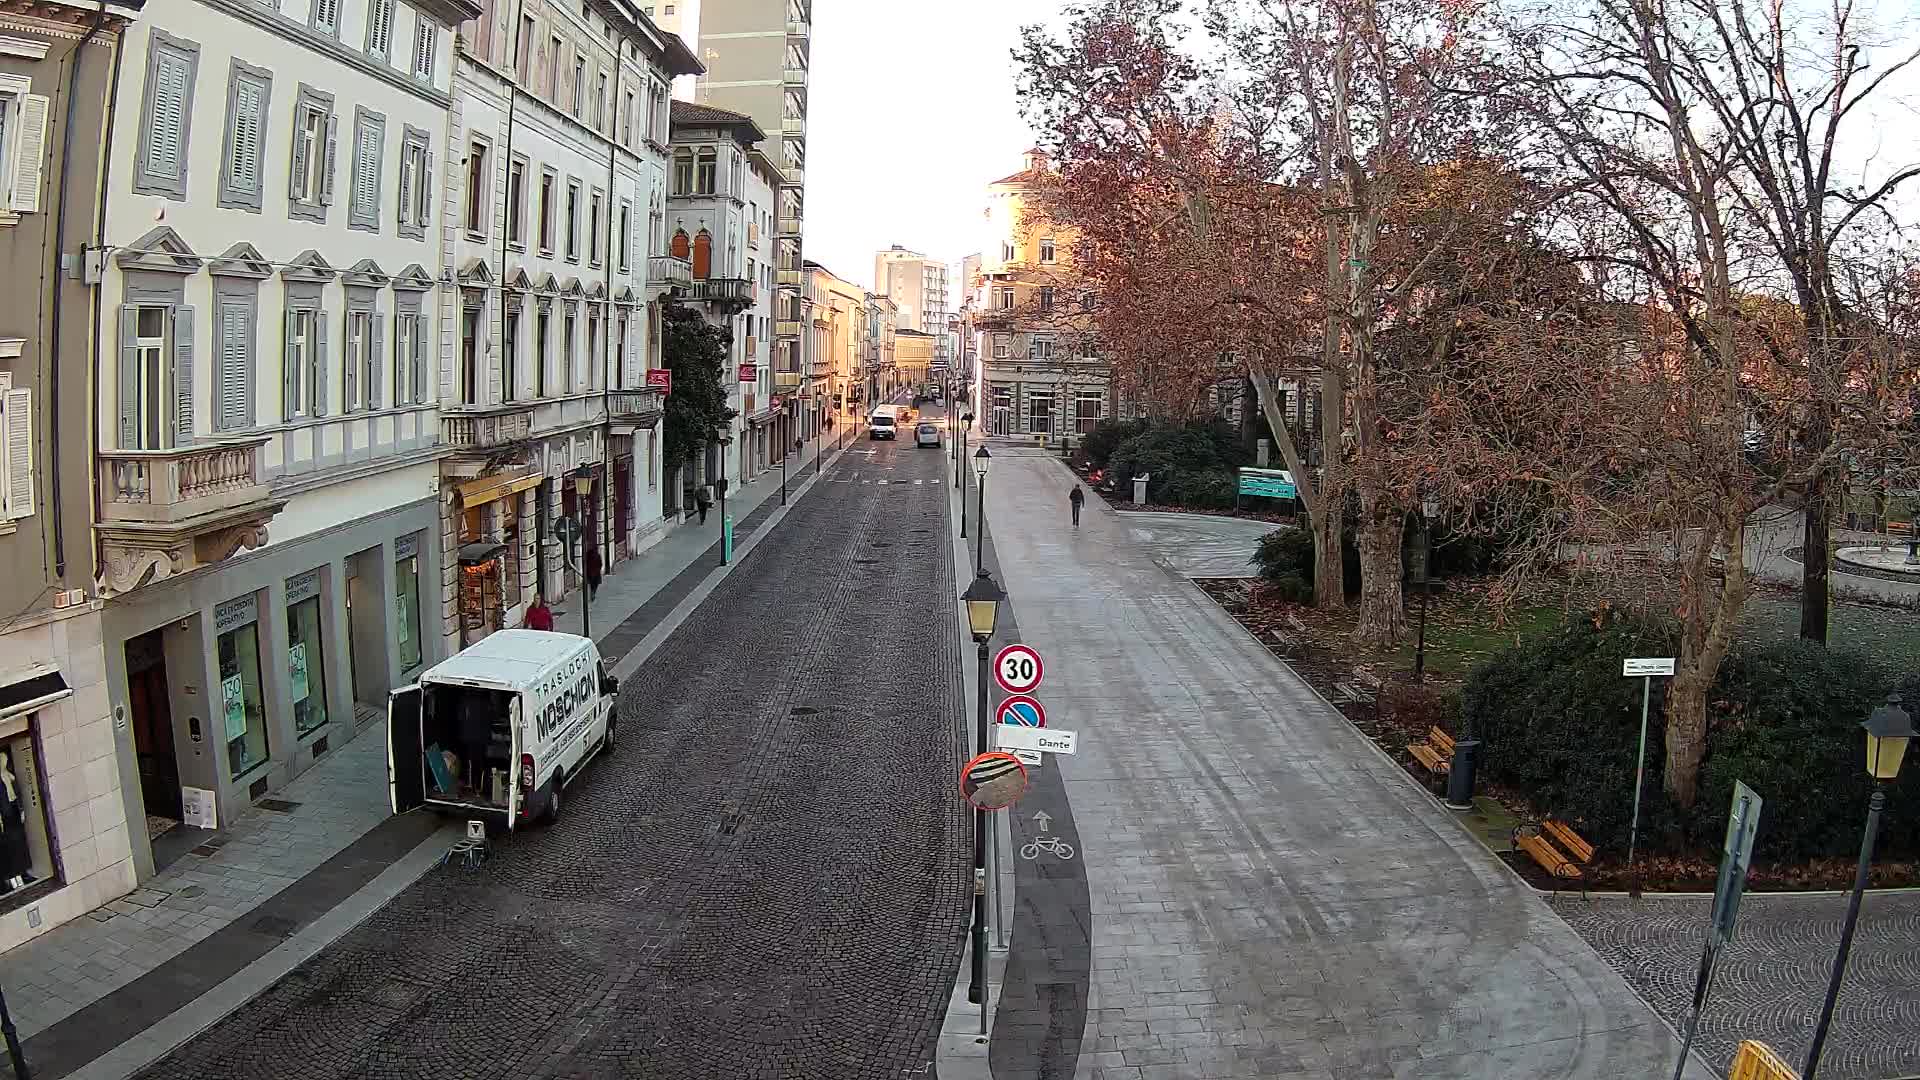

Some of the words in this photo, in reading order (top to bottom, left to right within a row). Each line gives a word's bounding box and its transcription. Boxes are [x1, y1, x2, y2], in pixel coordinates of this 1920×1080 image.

[536, 650, 591, 699] TRASLOCHI
[1005, 658, 1033, 680] 30
[223, 677, 241, 699] 130
[535, 670, 596, 743] MOSCHION
[1039, 738, 1070, 749] Dante
